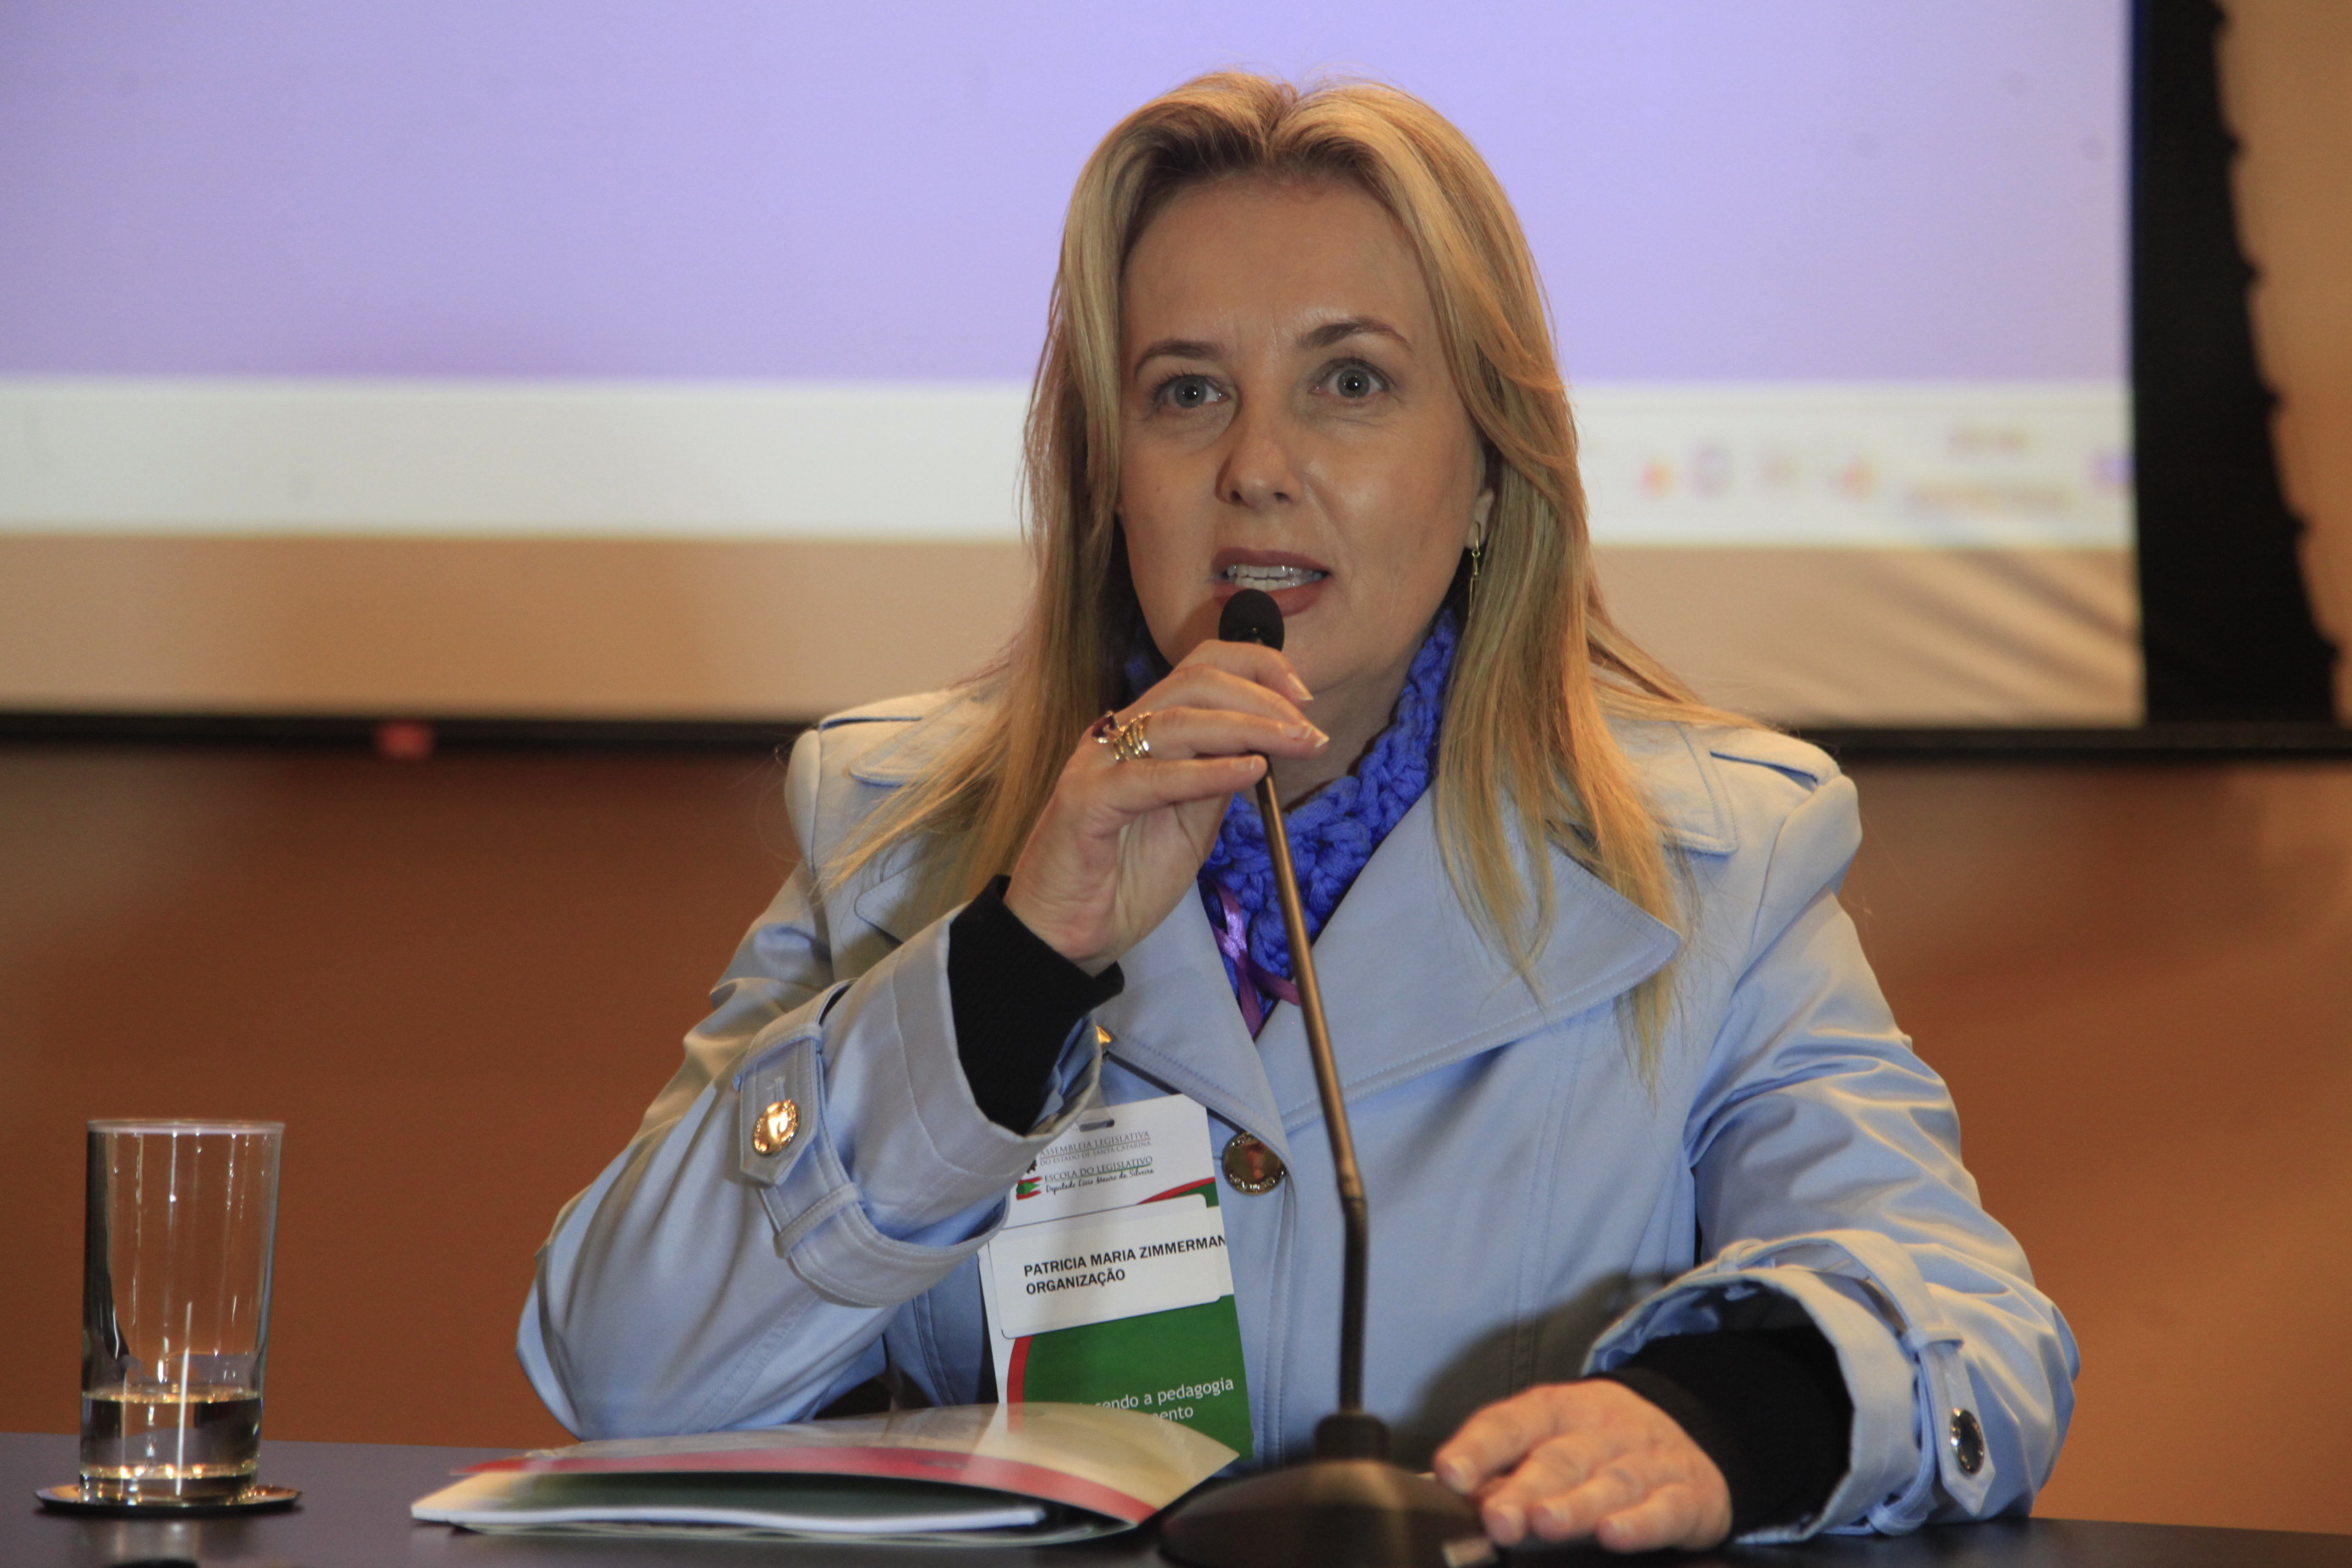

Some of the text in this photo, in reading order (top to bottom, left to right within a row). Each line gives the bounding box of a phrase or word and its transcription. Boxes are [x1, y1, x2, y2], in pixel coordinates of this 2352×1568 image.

[1093, 1146, 1114, 1156] SANTA
[1117, 1141, 1152, 1152] CATARINA
[1095, 1130, 1150, 1146] LEGISLATIVA
[1044, 1156, 1153, 1182] ESCOLA DO LEGISLATIVO
[1024, 1255, 1087, 1277] PATRICIA
[1090, 1248, 1136, 1266] MARIA
[1026, 1267, 1126, 1295] ORGANIZAÇÃO
[1143, 1393, 1152, 1406] a
[1157, 1377, 1234, 1406] pedagogia
[1152, 1406, 1194, 1421] ento
